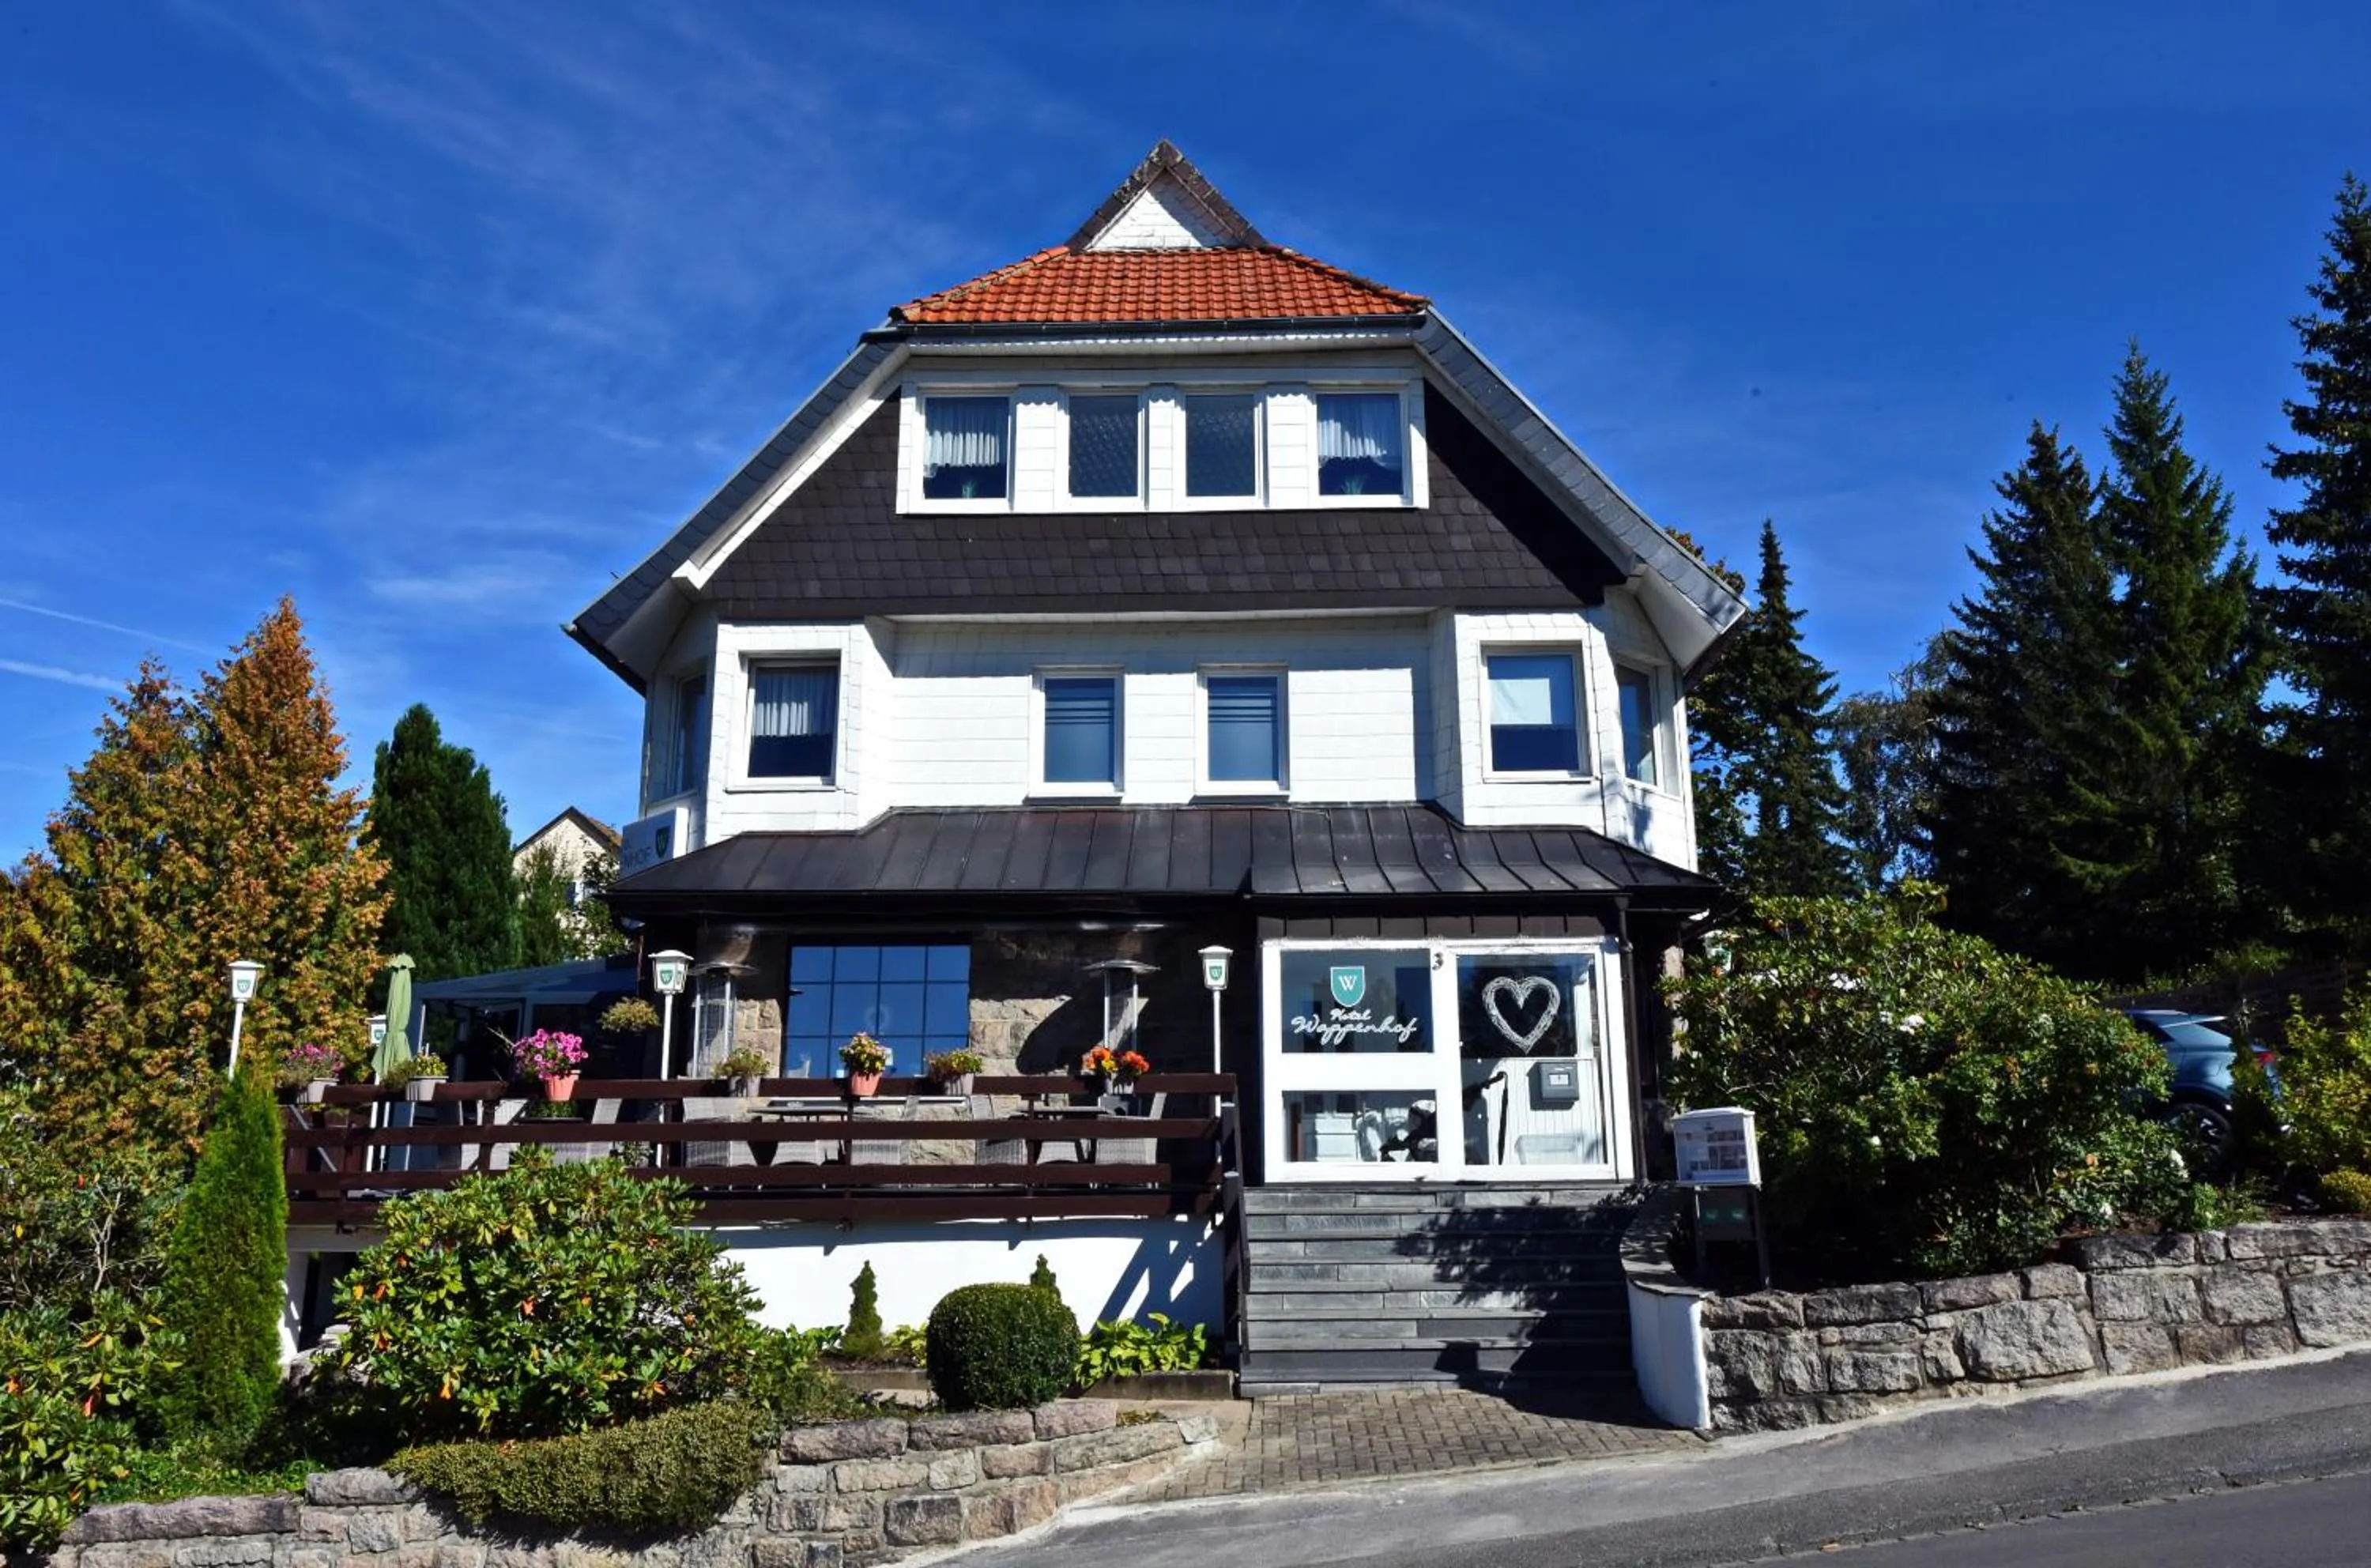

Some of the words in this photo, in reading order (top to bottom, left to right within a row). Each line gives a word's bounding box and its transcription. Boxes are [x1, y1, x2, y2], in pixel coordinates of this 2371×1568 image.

[1431, 952, 1444, 971] 3
[1337, 974, 1357, 991] W
[1330, 1008, 1371, 1020] Hotel
[1291, 1014, 1418, 1045] Wappenhof
